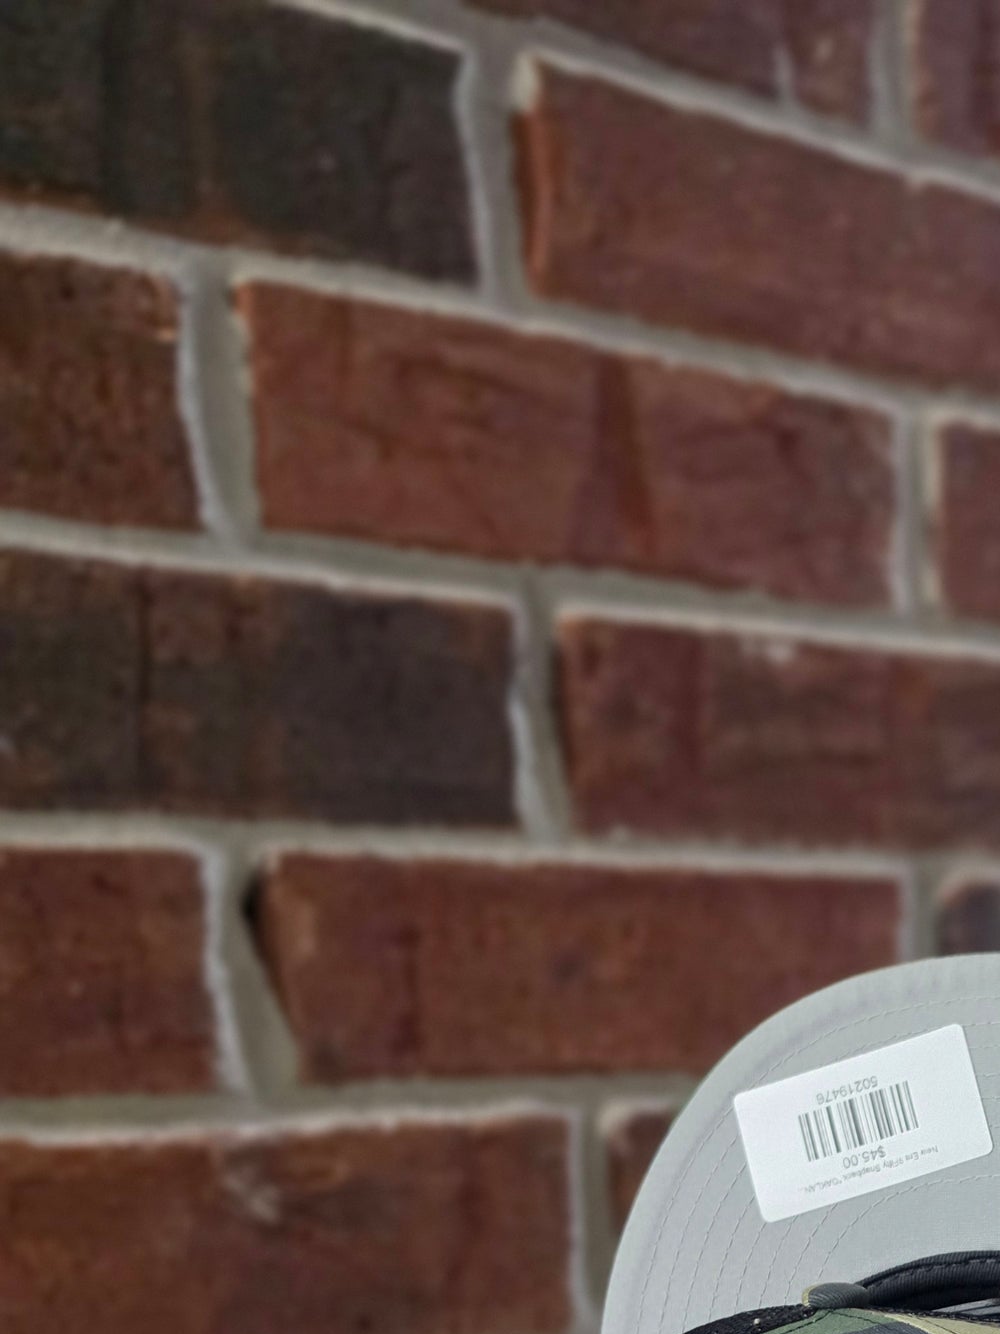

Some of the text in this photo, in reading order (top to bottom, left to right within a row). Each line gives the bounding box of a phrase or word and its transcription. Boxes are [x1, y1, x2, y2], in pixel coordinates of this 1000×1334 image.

[816, 1075, 878, 1105] 50219476
[843, 1145, 887, 1169] $45.00
[904, 1150, 920, 1161] Era
[920, 1145, 939, 1155] New
